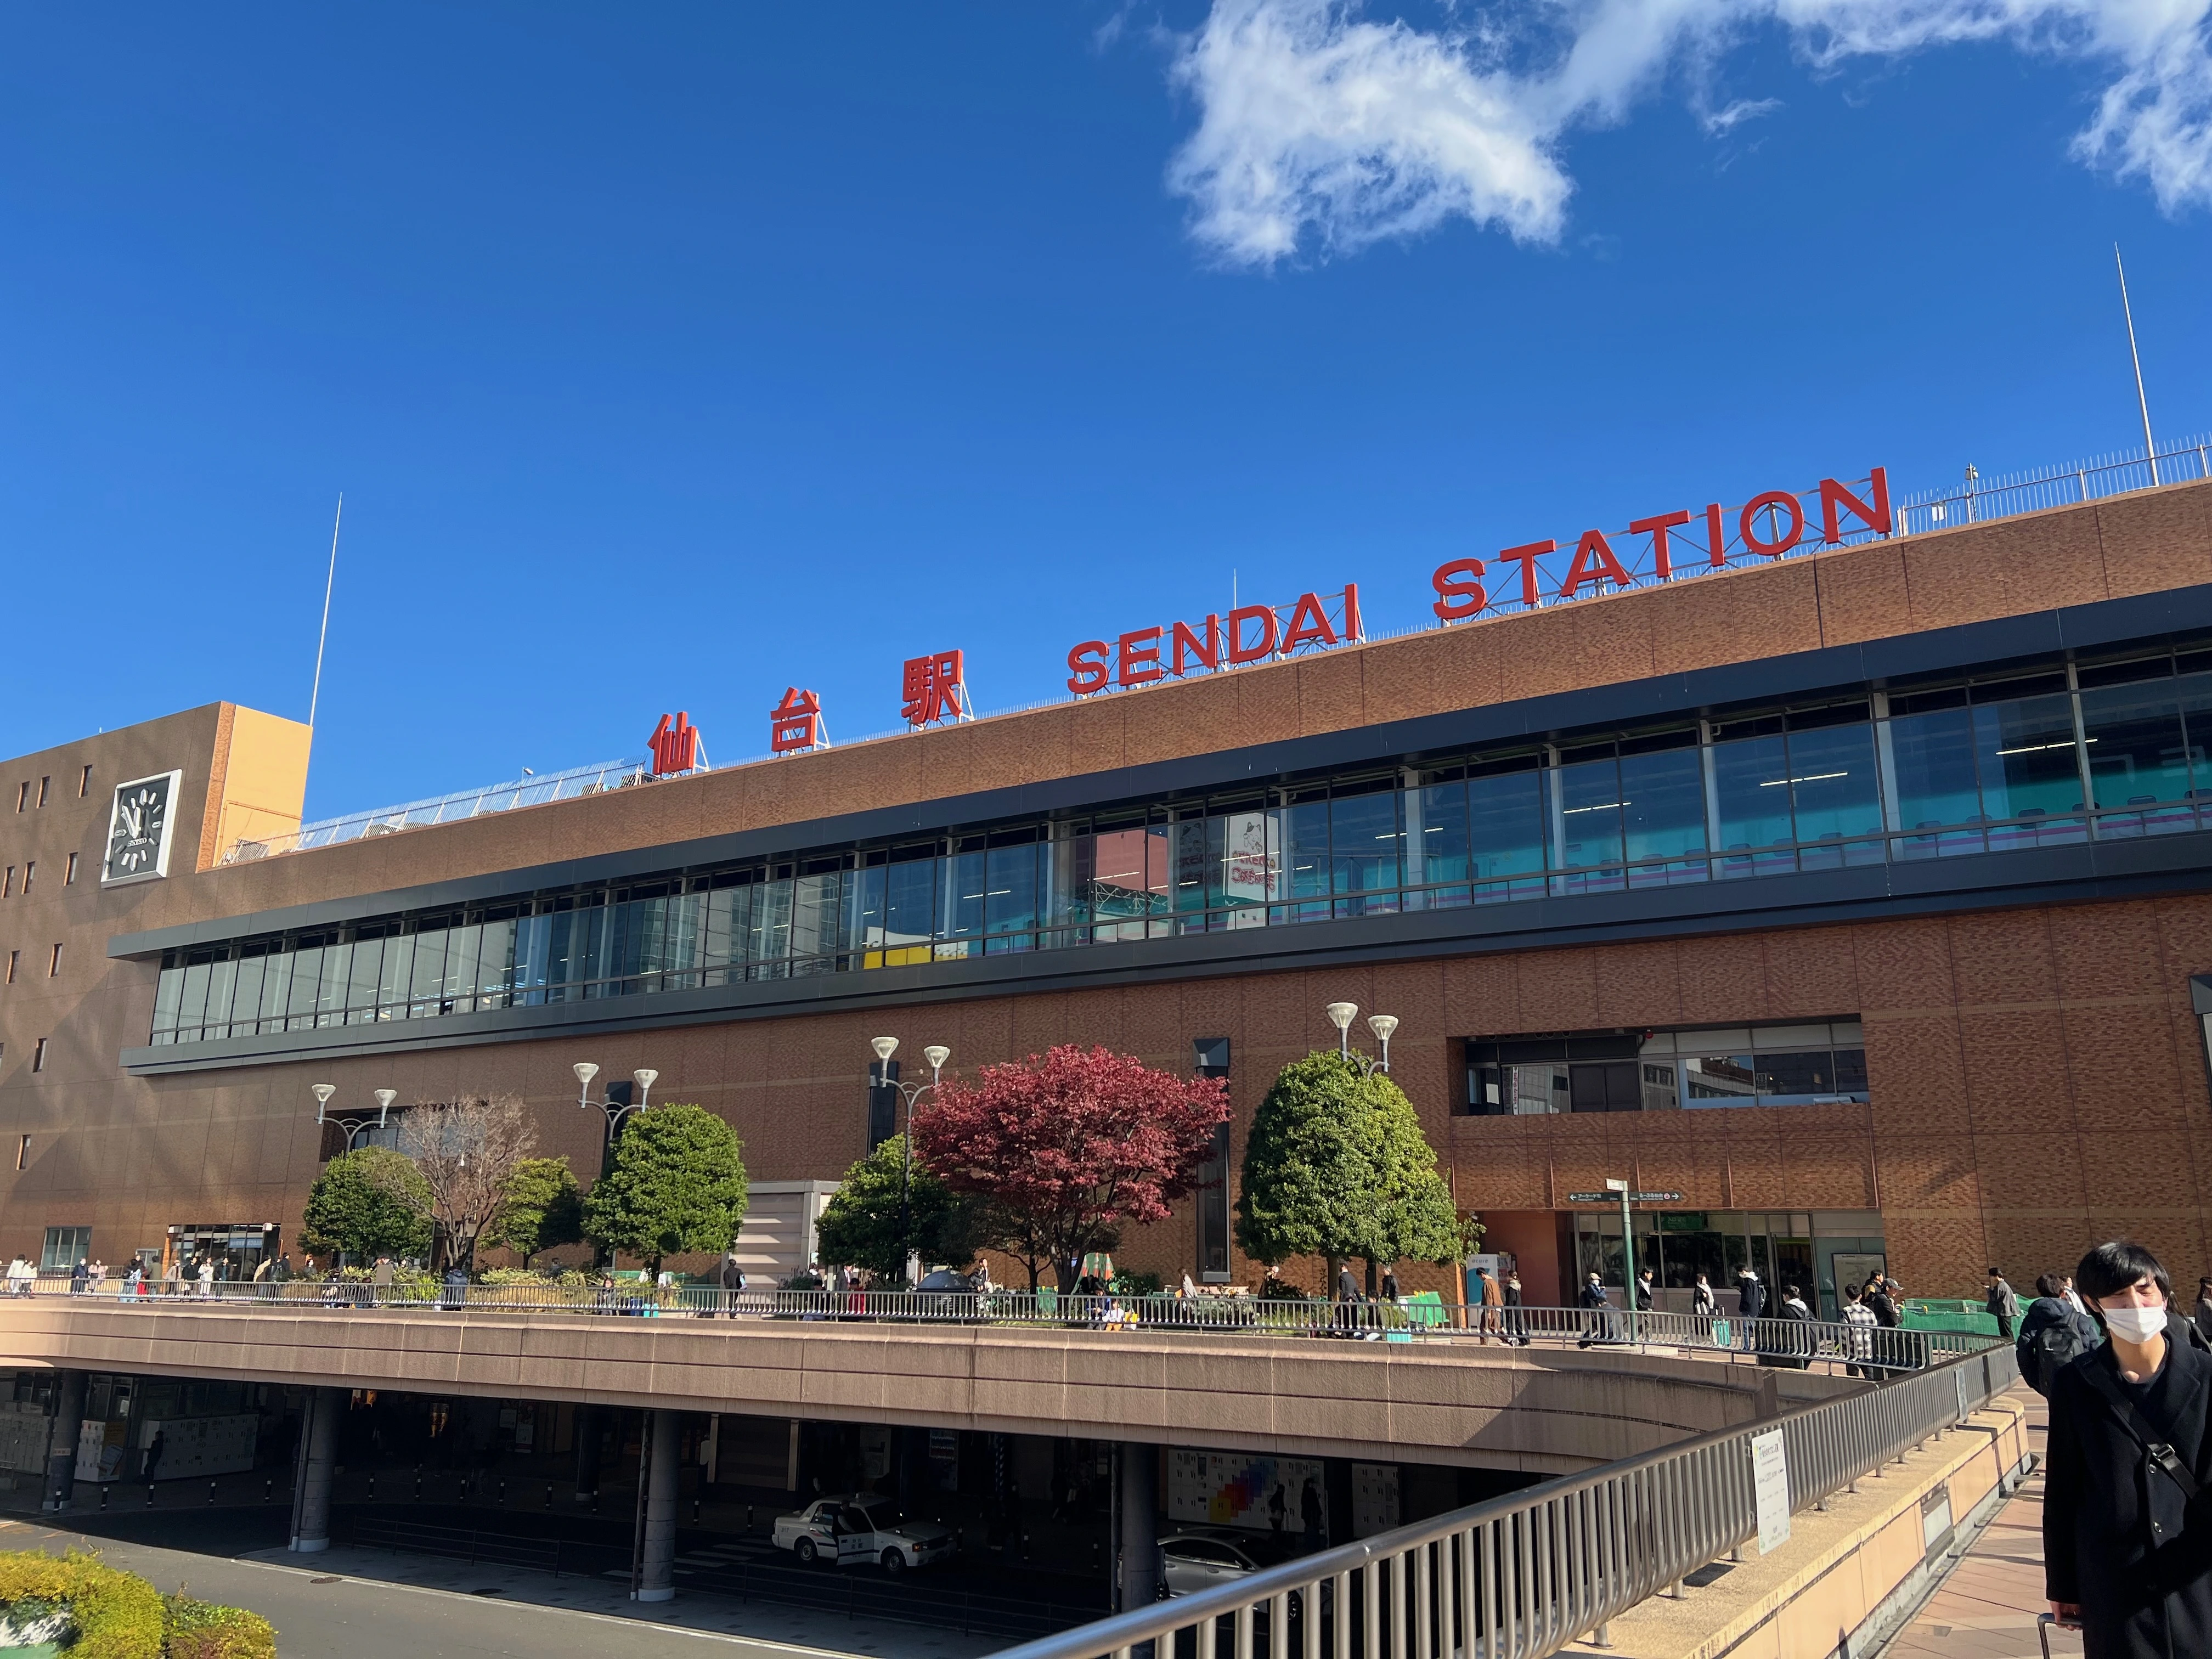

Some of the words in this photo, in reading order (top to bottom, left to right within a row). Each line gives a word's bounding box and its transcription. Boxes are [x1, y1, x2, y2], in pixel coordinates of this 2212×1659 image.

[647, 650, 963, 775] 仙台駅
[1067, 583, 1358, 694] SENDAI
[1432, 466, 1892, 619] STATION
[127, 837, 147, 847] SEIKO
